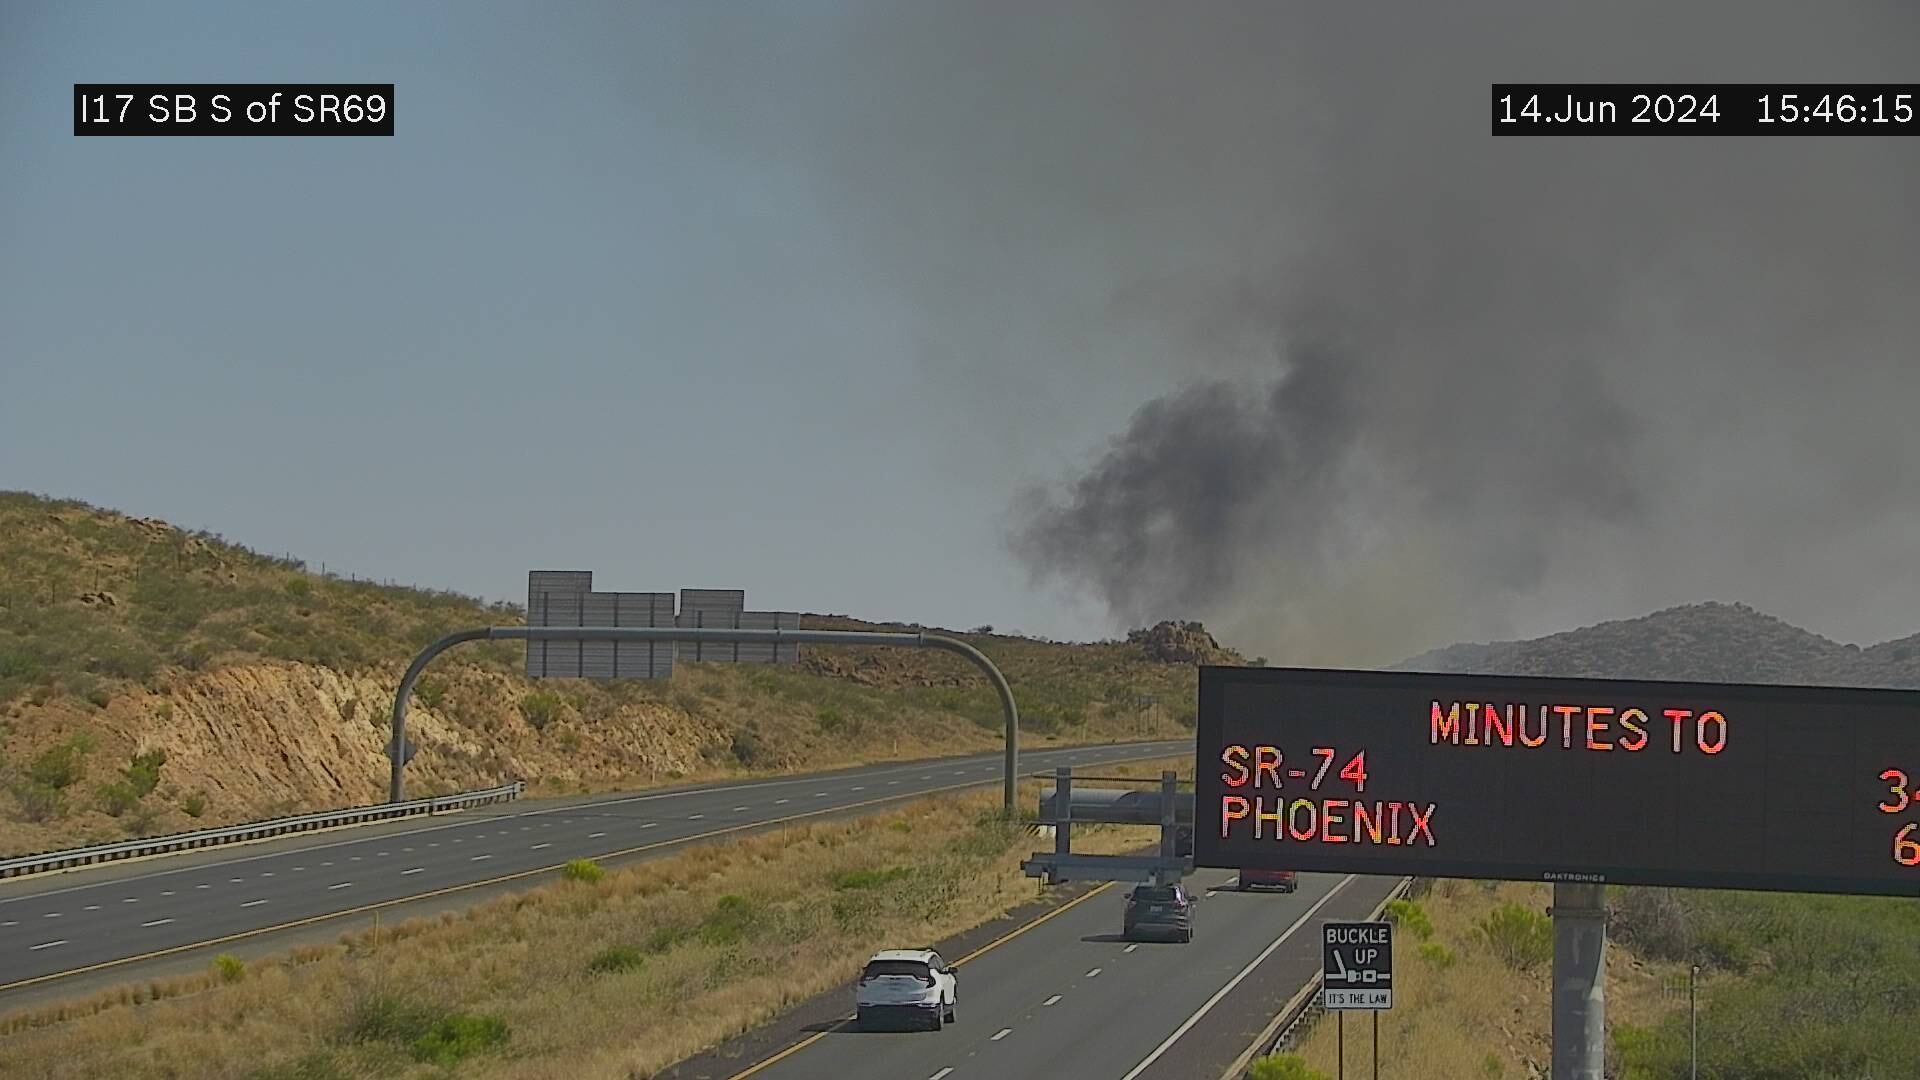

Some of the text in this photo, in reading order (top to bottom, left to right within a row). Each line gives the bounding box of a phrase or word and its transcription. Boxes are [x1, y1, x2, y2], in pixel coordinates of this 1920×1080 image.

[1430, 701, 1728, 754] MINUTES TO
[1221, 745, 1920, 813] SR-74 3
[1221, 796, 1438, 846] PHOENIX
[1326, 928, 1388, 944] BUCKLE
[1355, 948, 1378, 965] UP
[1349, 993, 1365, 1004] THE
[1369, 993, 1387, 1004] LAW
